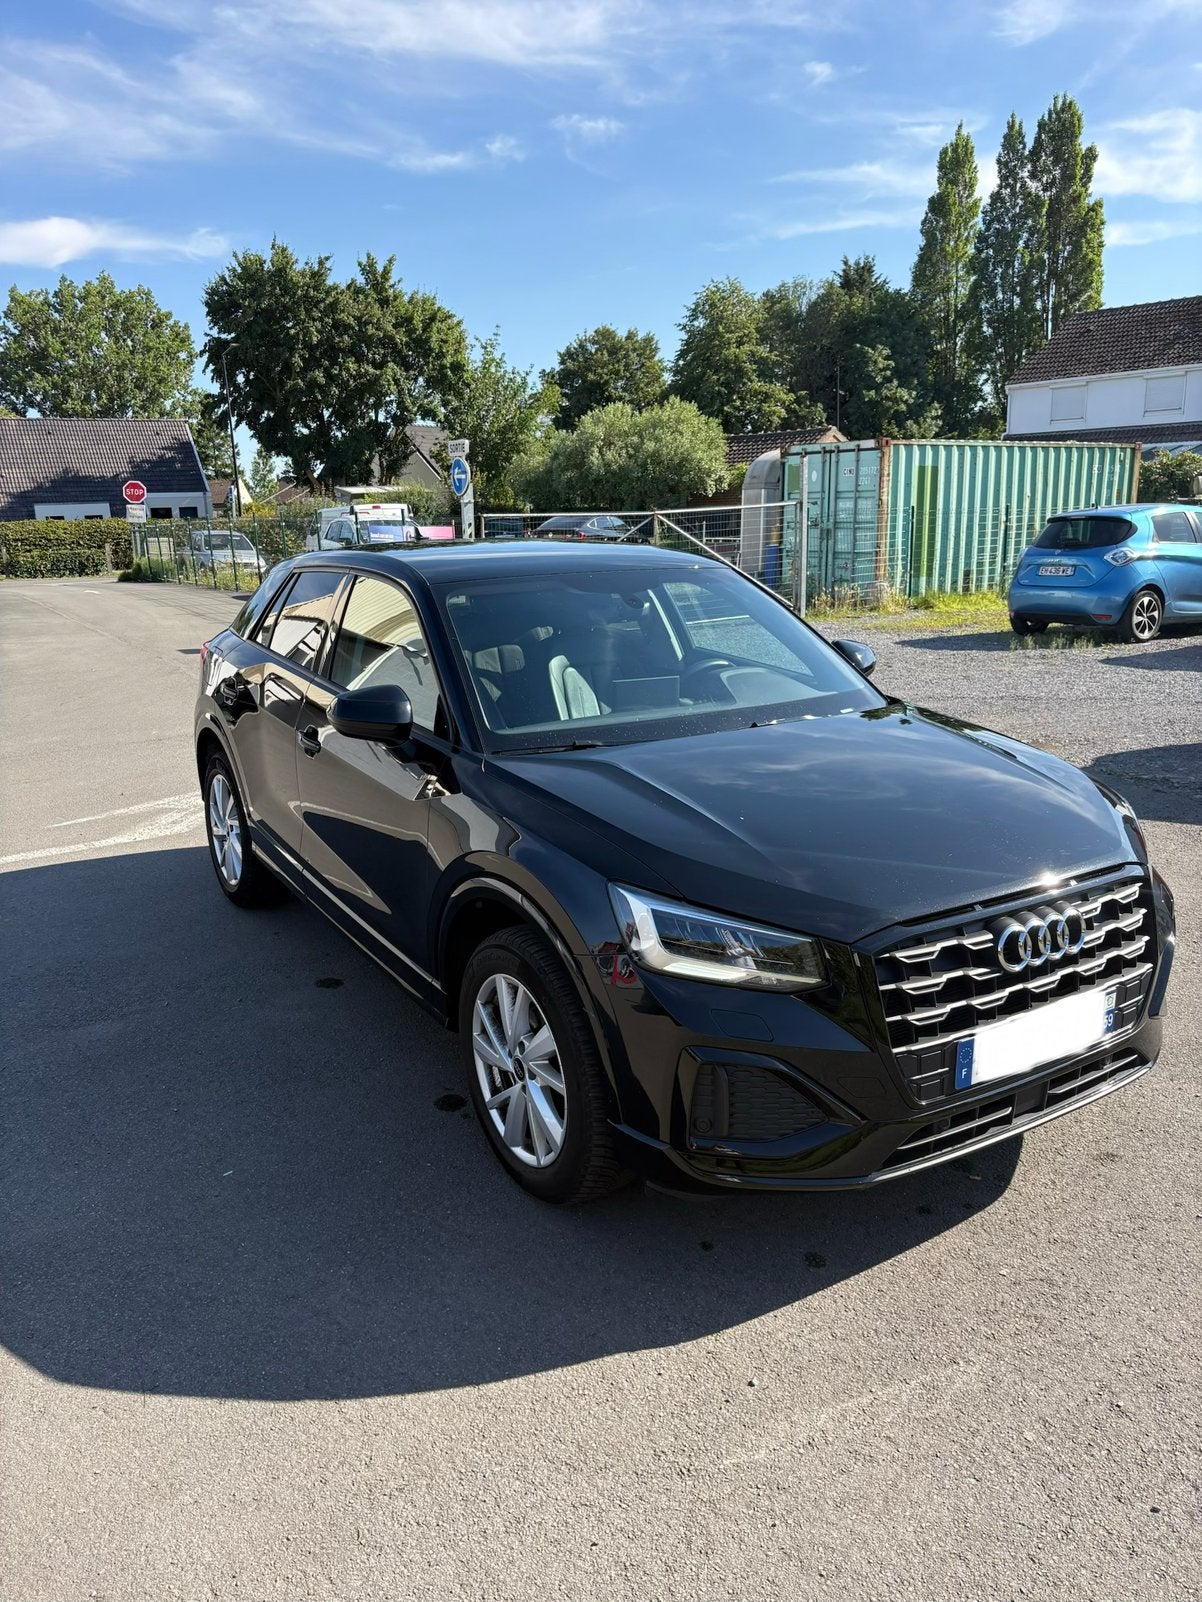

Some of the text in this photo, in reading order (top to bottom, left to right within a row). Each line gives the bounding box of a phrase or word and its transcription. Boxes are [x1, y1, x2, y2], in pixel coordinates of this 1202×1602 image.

[450, 443, 465, 453] SORTIE
[126, 488, 144, 496] STOP
[961, 1068, 968, 1079] F
